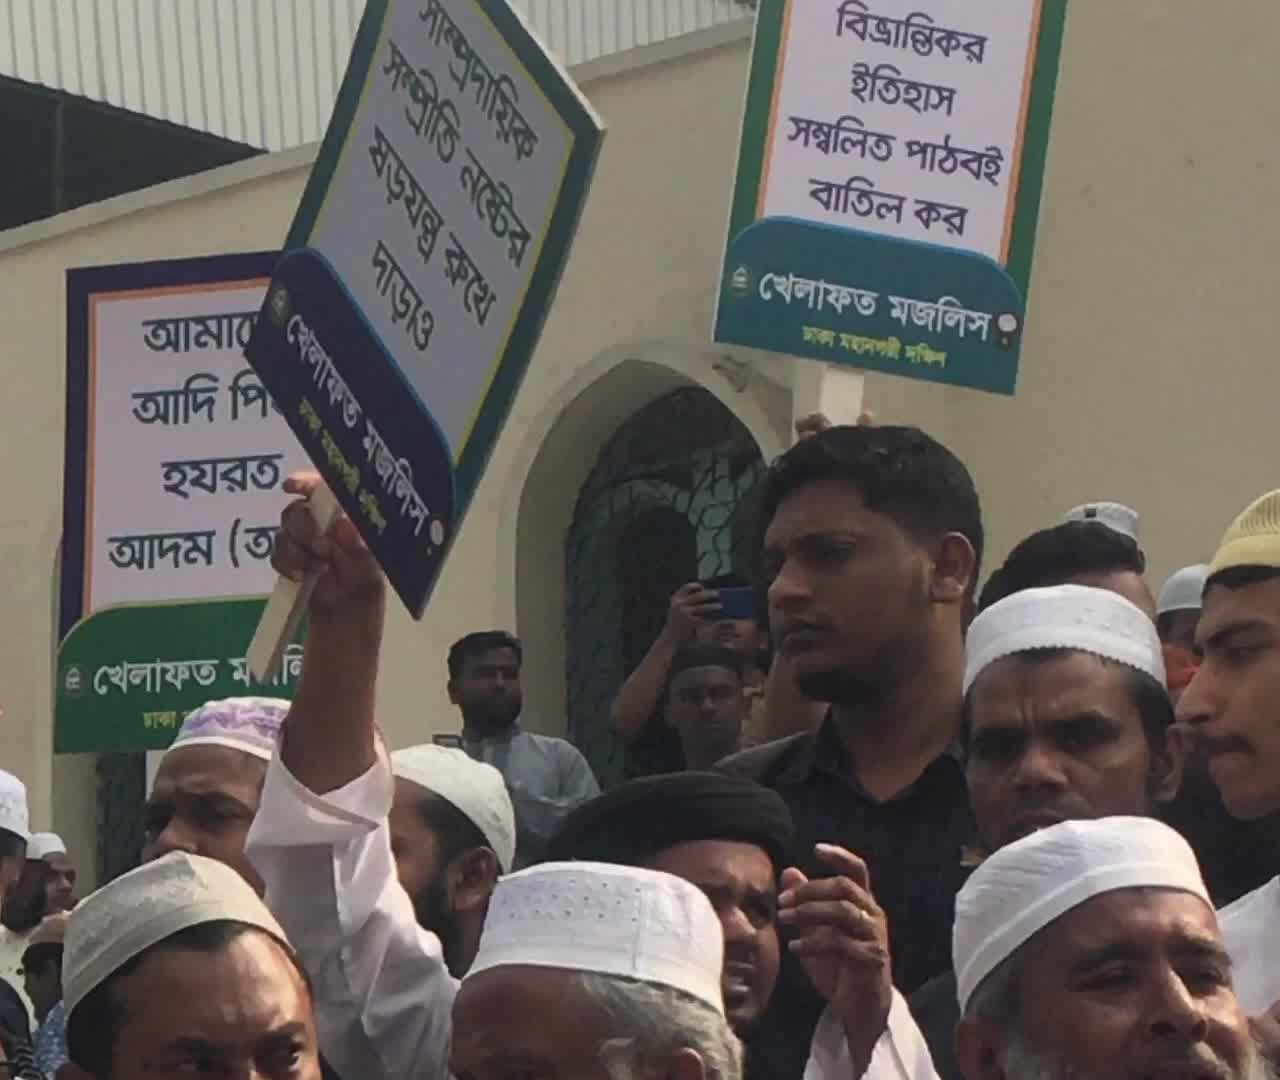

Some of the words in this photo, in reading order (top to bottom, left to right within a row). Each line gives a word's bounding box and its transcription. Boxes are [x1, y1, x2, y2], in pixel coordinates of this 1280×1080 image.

[836, 0, 987, 64] বিভ্রান্তিকর
[850, 62, 956, 116] ইতিহাস
[788, 115, 896, 162] সম্বলিত
[905, 134, 1004, 187] পাঠবই
[809, 175, 906, 224] বাতিল
[914, 199, 968, 236] কর
[759, 272, 880, 316] খেলাফত
[888, 296, 992, 341] মজলিস
[132, 373, 218, 425] আদি
[287, 314, 362, 428] খেলাফত
[362, 419, 429, 536] মজলিস
[161, 453, 283, 499] হযরত
[107, 531, 216, 571] আদম
[93, 657, 219, 695] খেলাফত
